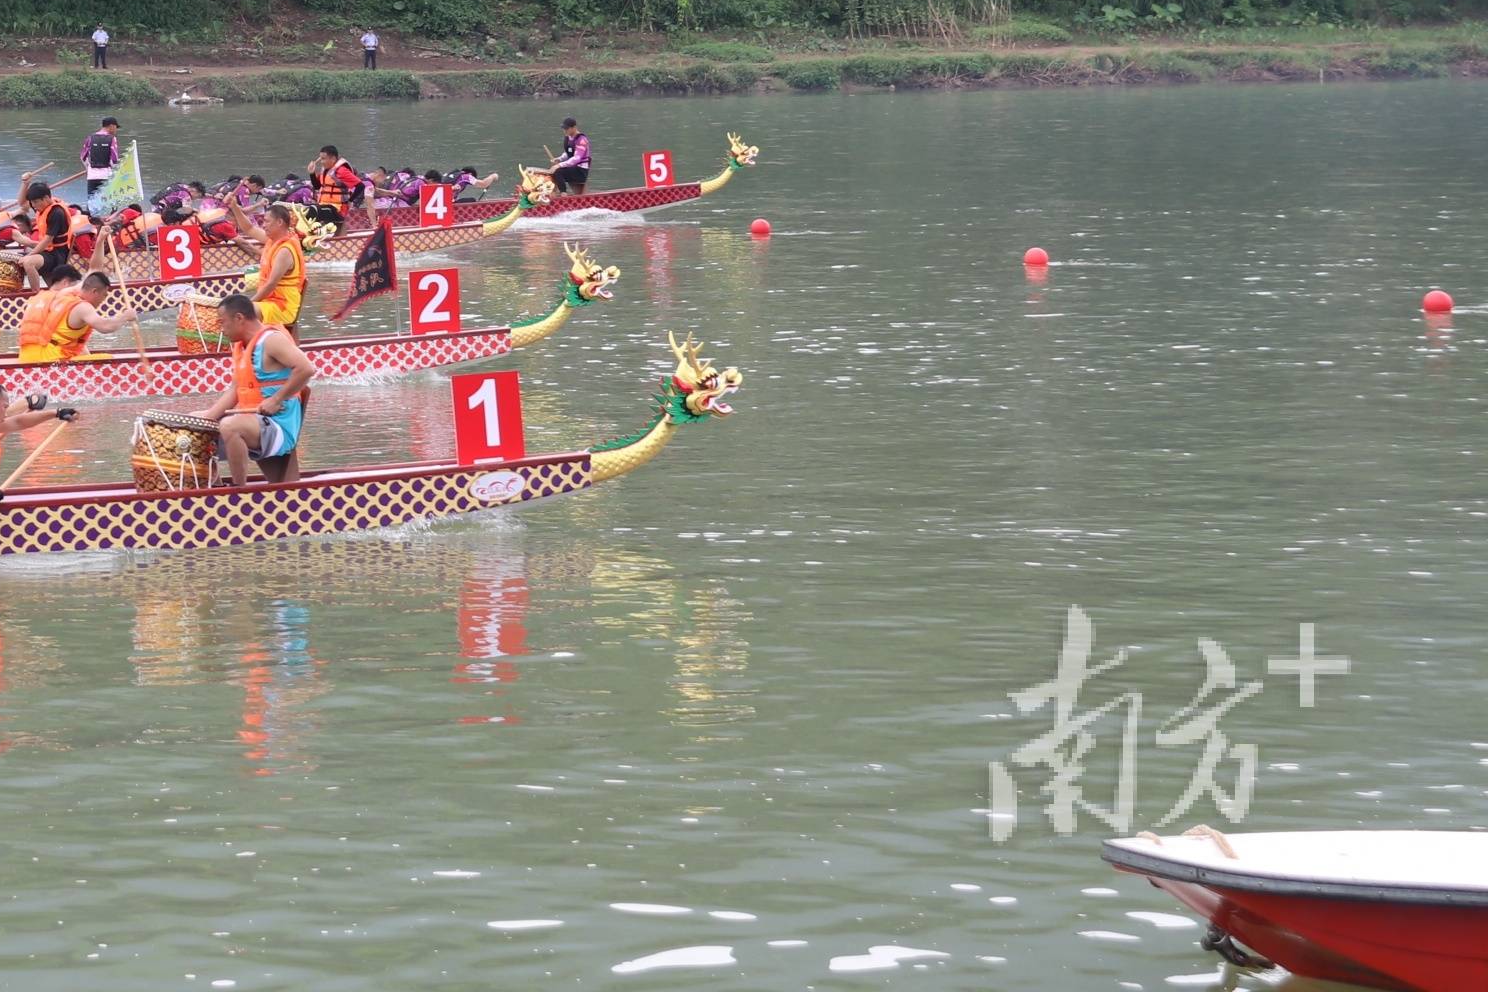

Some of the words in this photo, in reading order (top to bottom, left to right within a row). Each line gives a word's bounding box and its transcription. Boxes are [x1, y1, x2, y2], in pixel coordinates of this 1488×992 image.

[650, 154, 667, 182] 5
[425, 187, 447, 219] 4
[166, 229, 192, 270] 3
[418, 273, 450, 323] 2
[468, 378, 501, 447] 1
